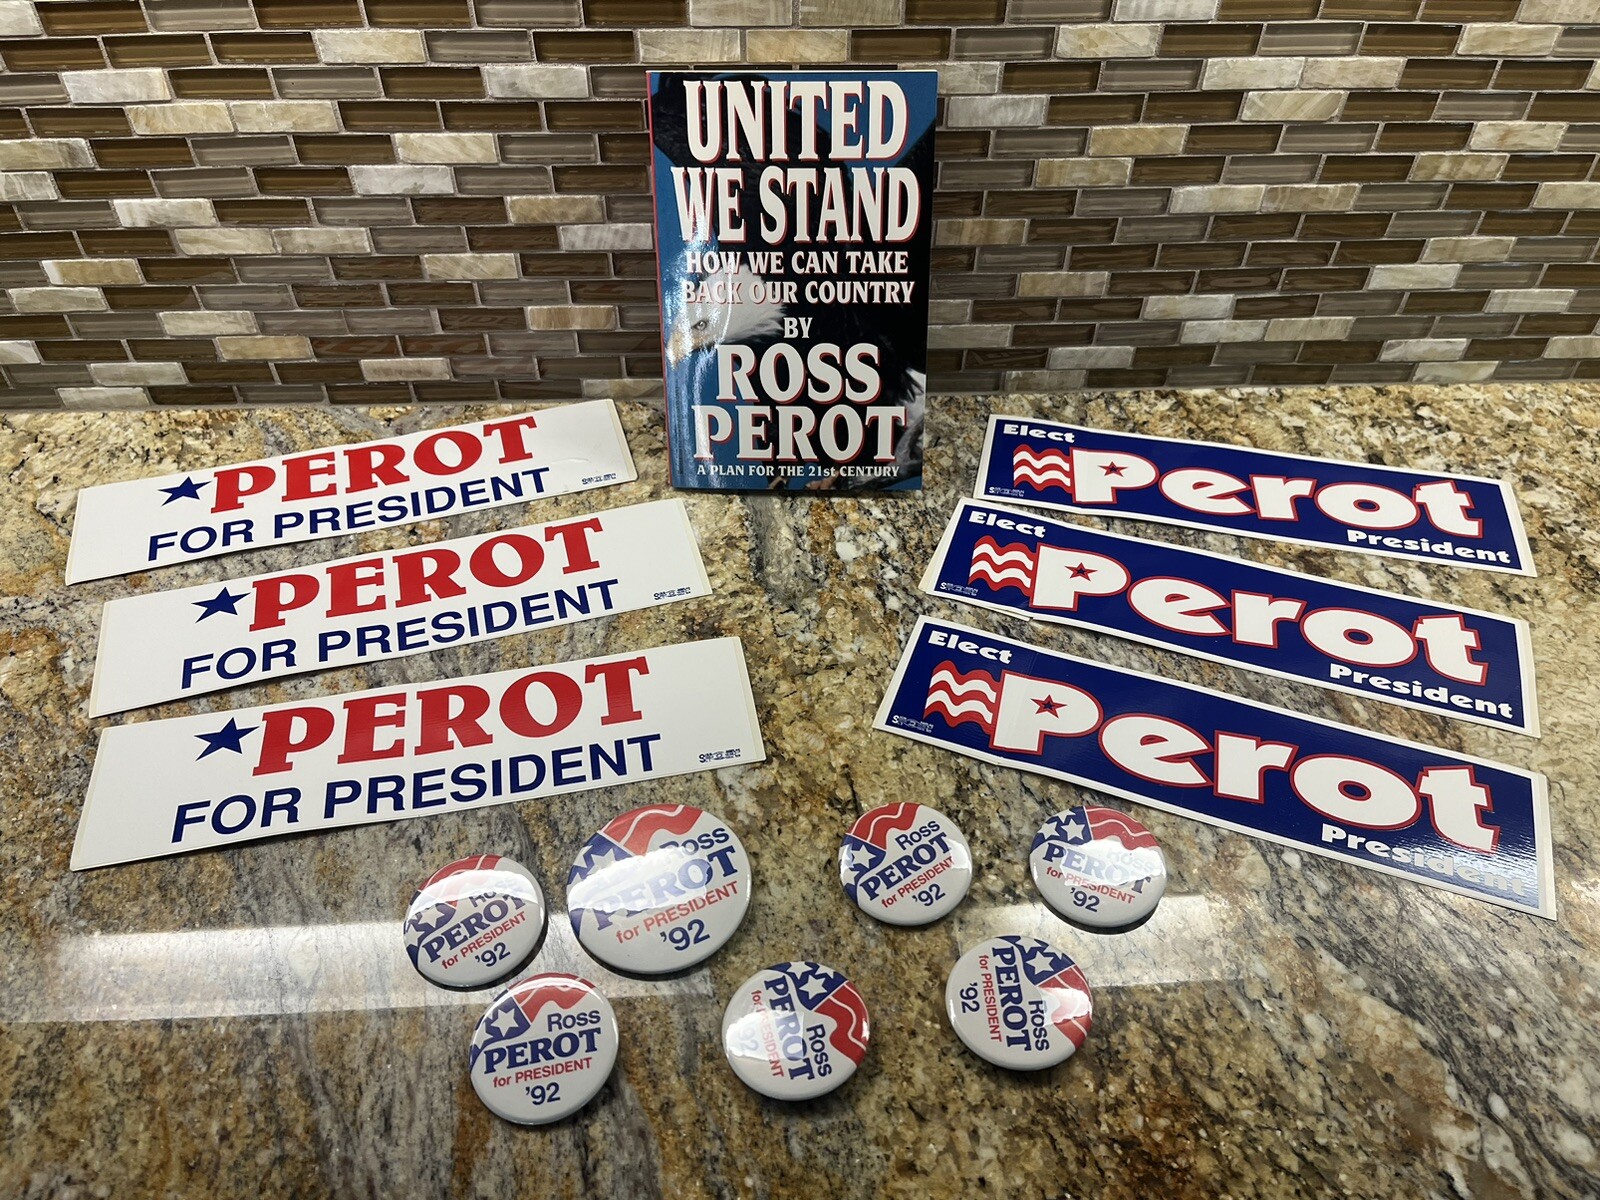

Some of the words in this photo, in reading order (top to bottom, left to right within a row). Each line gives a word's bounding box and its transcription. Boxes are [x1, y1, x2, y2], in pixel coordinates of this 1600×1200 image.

[683, 80, 909, 164] UNITED
[671, 166, 746, 243] WE
[759, 165, 921, 245] STAND
[686, 251, 741, 274] HOW
[747, 251, 785, 274] WE
[791, 251, 838, 274] CAN
[845, 251, 908, 274] TAKE
[684, 281, 743, 304] BACK
[752, 281, 799, 304] OUR
[805, 281, 915, 304] COUNTRY
[783, 317, 813, 339] BY
[716, 342, 882, 404] ROSS
[691, 404, 907, 463] PEROT
[1003, 423, 1075, 443] Elect
[210, 416, 537, 514] PEROT
[697, 465, 706, 477] A
[710, 465, 745, 477] PLAN
[748, 465, 774, 477] FOR
[777, 465, 805, 477] THE
[807, 465, 836, 477] 21st
[839, 465, 900, 477] CENTURY
[1069, 446, 1484, 539] Perot
[148, 518, 254, 561] FOR
[274, 467, 549, 538] PRESIDENT
[968, 511, 1046, 538] Elect
[249, 518, 602, 632] PEROT
[1347, 529, 1510, 565] President
[181, 638, 297, 689] FOR
[318, 578, 619, 663] PRESIDENT
[1029, 542, 1490, 686] Perot
[928, 630, 1013, 666] Elect
[252, 655, 649, 776] PEROT
[1329, 663, 1513, 719] President
[171, 786, 302, 843] FOR
[324, 733, 662, 819] PRESIDENT
[990, 669, 1501, 855] Perot
[594, 845, 738, 931] PEROT
[859, 832, 951, 901] PEROT
[881, 894, 898, 908] for
[897, 856, 954, 897] PRESIDENT
[1042, 842, 1151, 894] PEROT
[1046, 866, 1063, 879] for
[1065, 873, 1135, 904] PRESIDENT
[1321, 823, 1525, 896] President
[616, 926, 641, 944] for
[643, 881, 738, 931] PRESIDENT
[912, 884, 946, 906] '92
[1070, 887, 1100, 912] '92
[422, 894, 526, 963] PEROT
[441, 954, 459, 969] for
[460, 911, 526, 958] PRESIDENT
[474, 942, 511, 967] '92
[660, 919, 710, 951] '92
[979, 955, 989, 970] for
[751, 990, 763, 1005] for
[960, 982, 980, 1013] '92
[981, 972, 1002, 1042] PRESIDENT
[992, 946, 1032, 1051] PEROT
[484, 1027, 601, 1074] PEROT
[764, 975, 815, 1080] PEROT
[493, 1076, 511, 1087] for
[515, 1057, 592, 1083] PRESIDENT
[525, 1082, 560, 1105] '92
